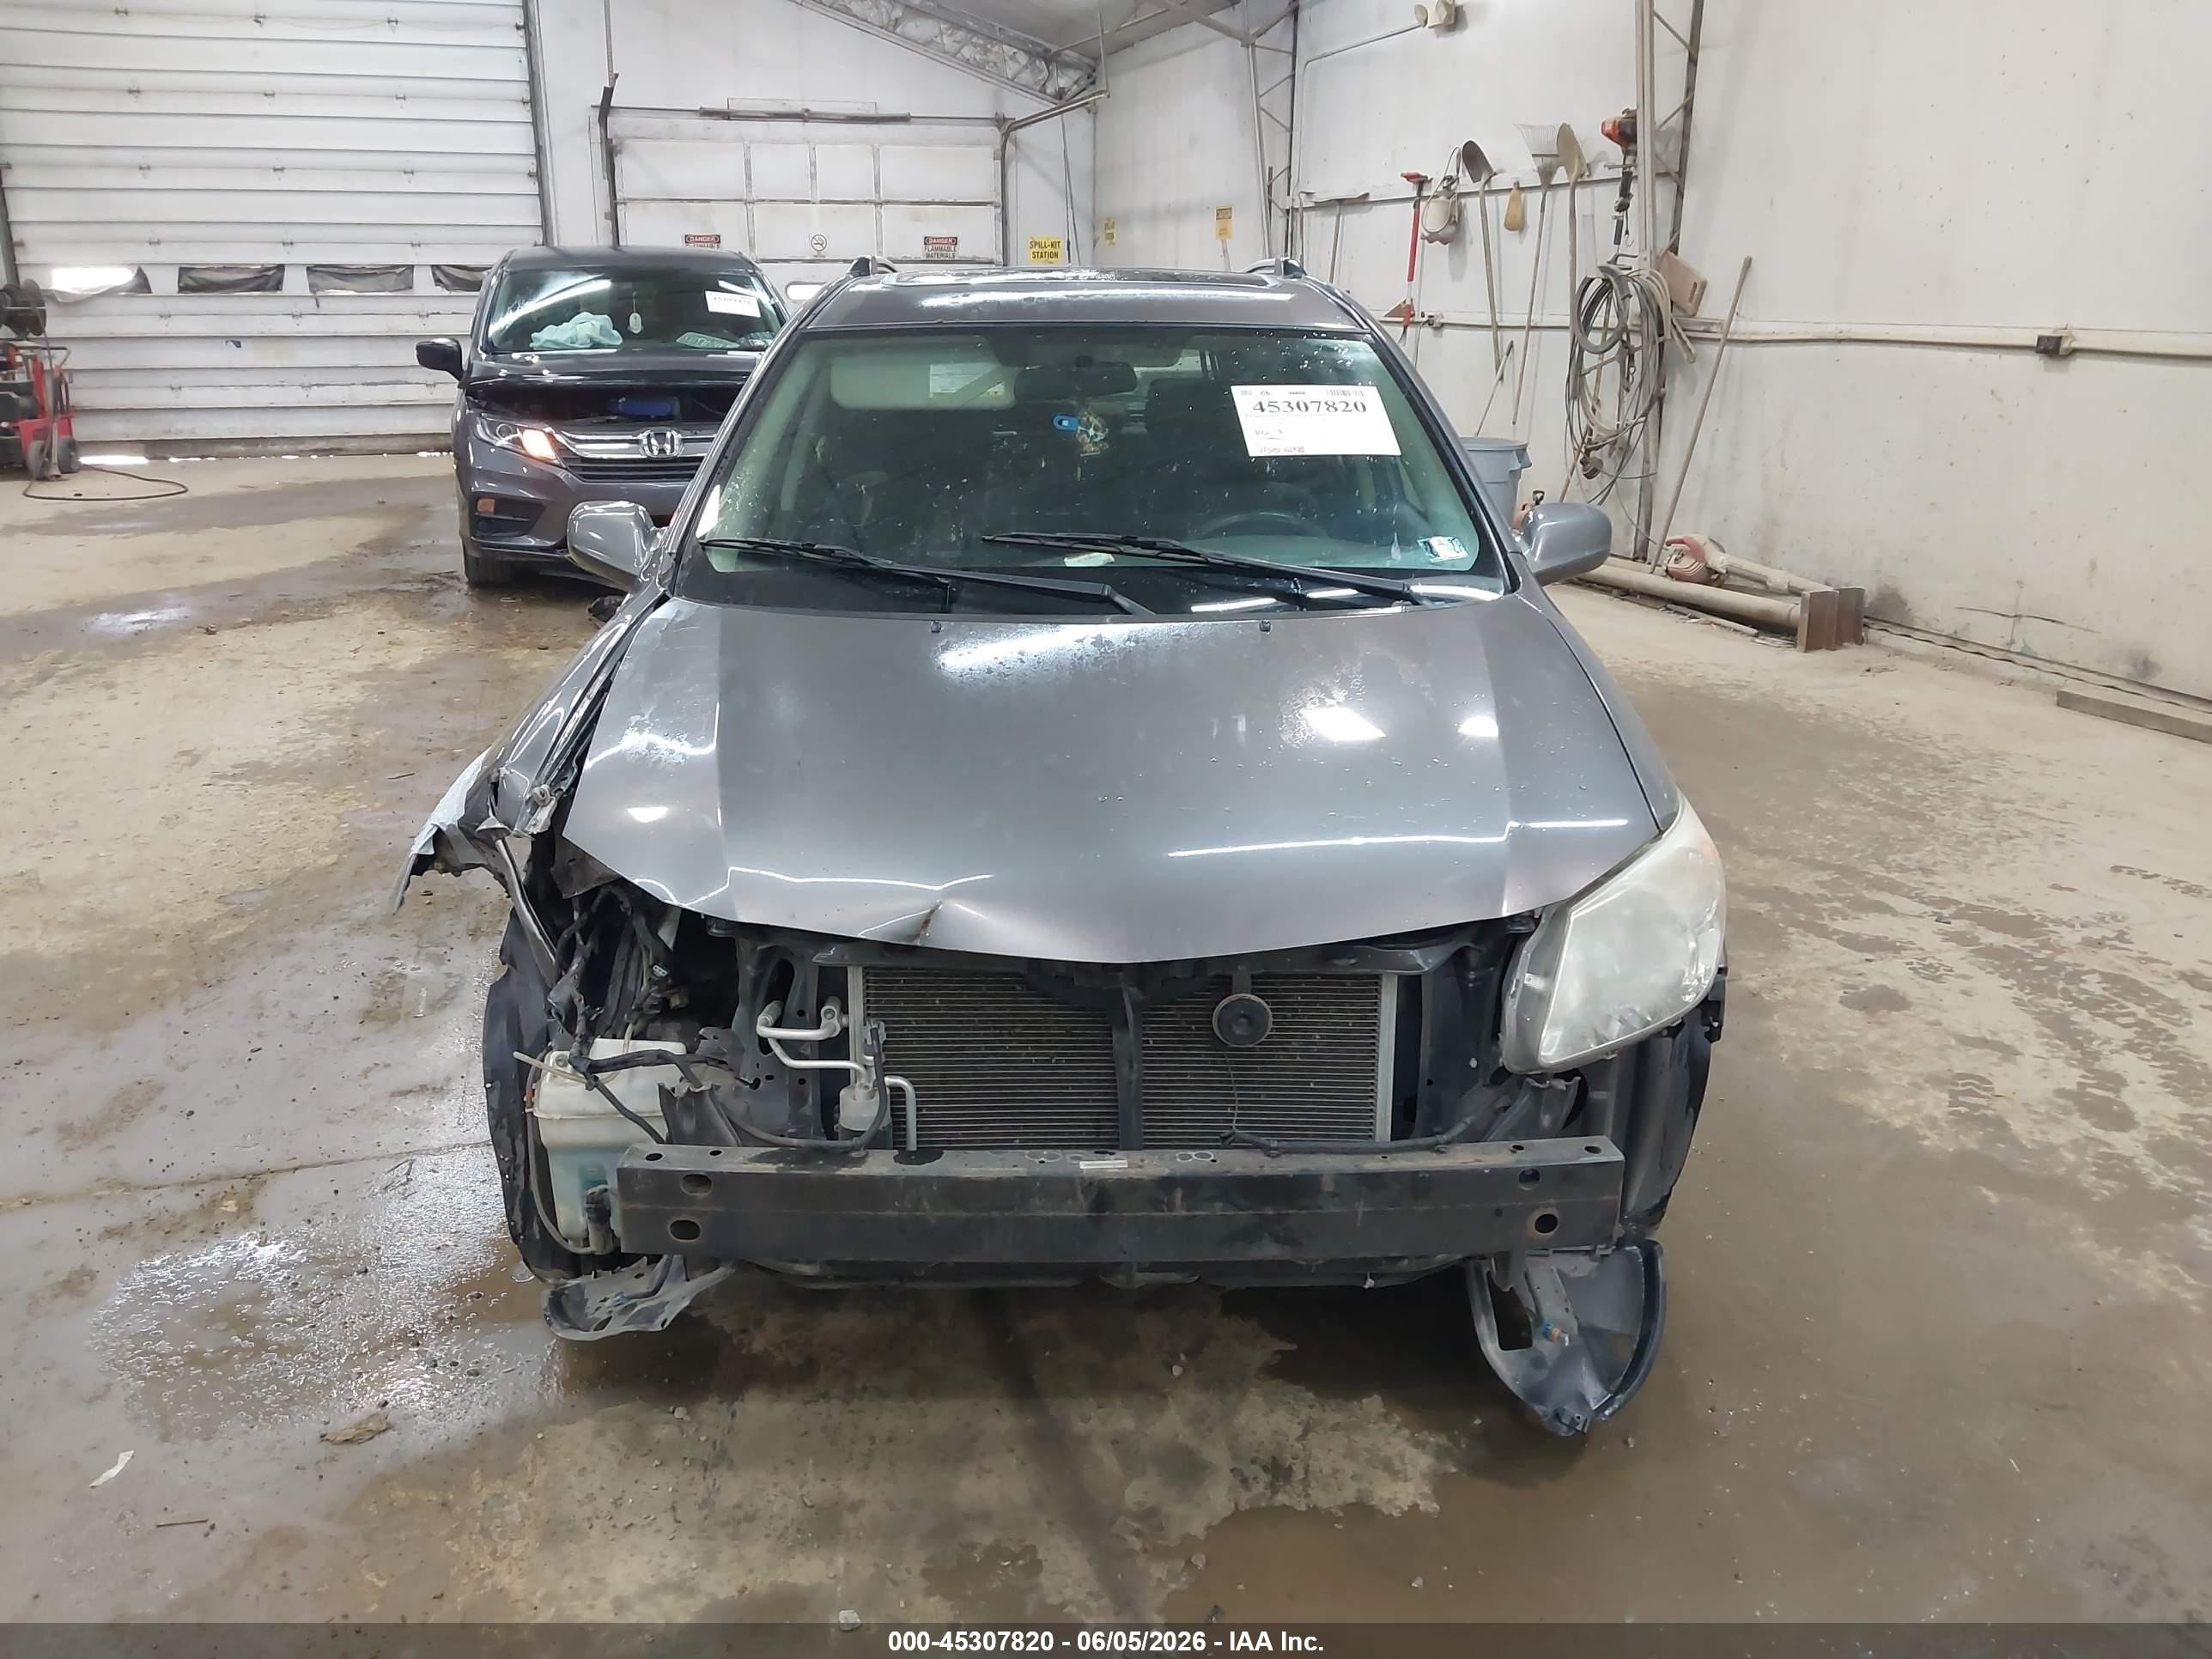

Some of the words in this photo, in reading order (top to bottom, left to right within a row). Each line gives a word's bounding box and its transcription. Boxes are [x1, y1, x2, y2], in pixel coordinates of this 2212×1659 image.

[1030, 240, 1061, 249] SPILL-KIT
[1031, 251, 1059, 259] STATION
[1252, 400, 1367, 413] 45307820
